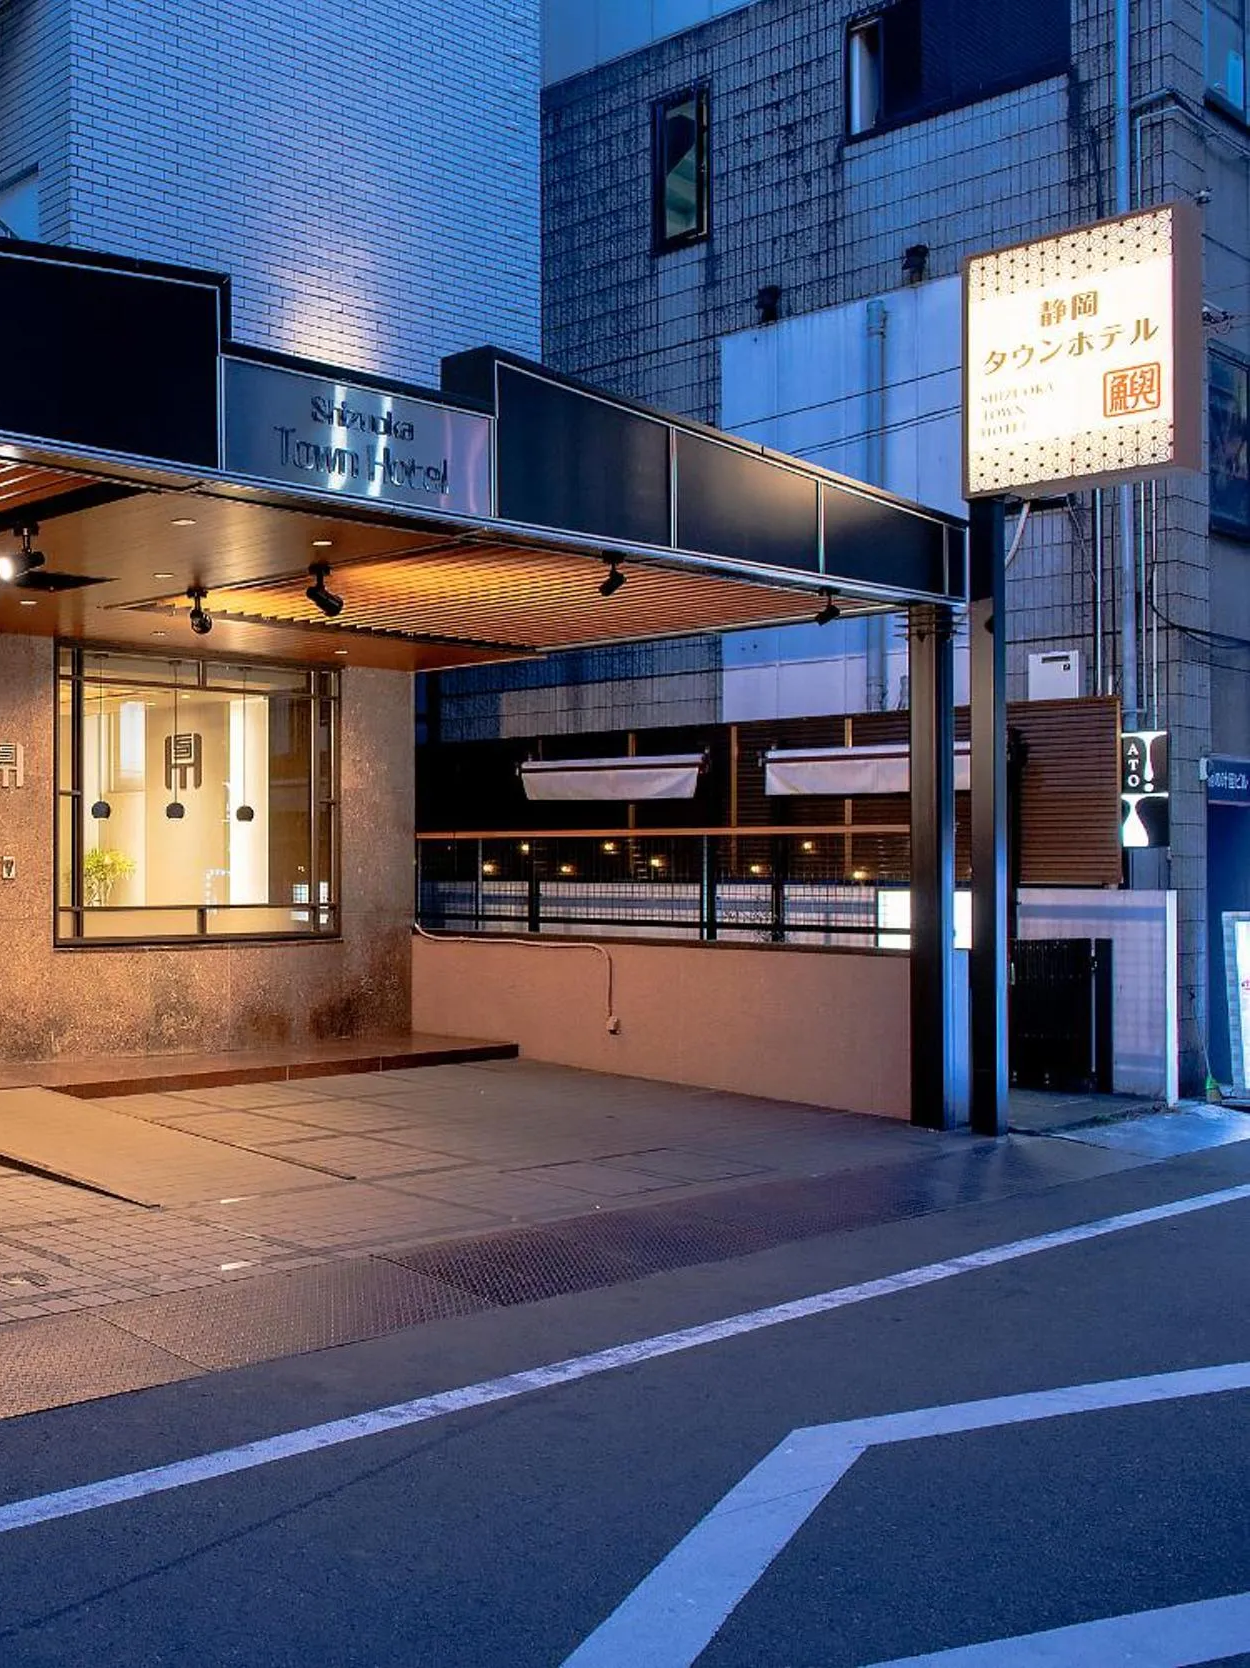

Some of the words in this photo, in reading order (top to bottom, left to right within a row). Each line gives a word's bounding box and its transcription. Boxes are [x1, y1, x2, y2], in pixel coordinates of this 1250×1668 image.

[1040, 291, 1098, 327] 静岡
[984, 318, 1159, 375] タウンホテル
[274, 426, 359, 479] Town
[366, 444, 450, 495] Hotel
[1127, 743, 1141, 788] ATO
